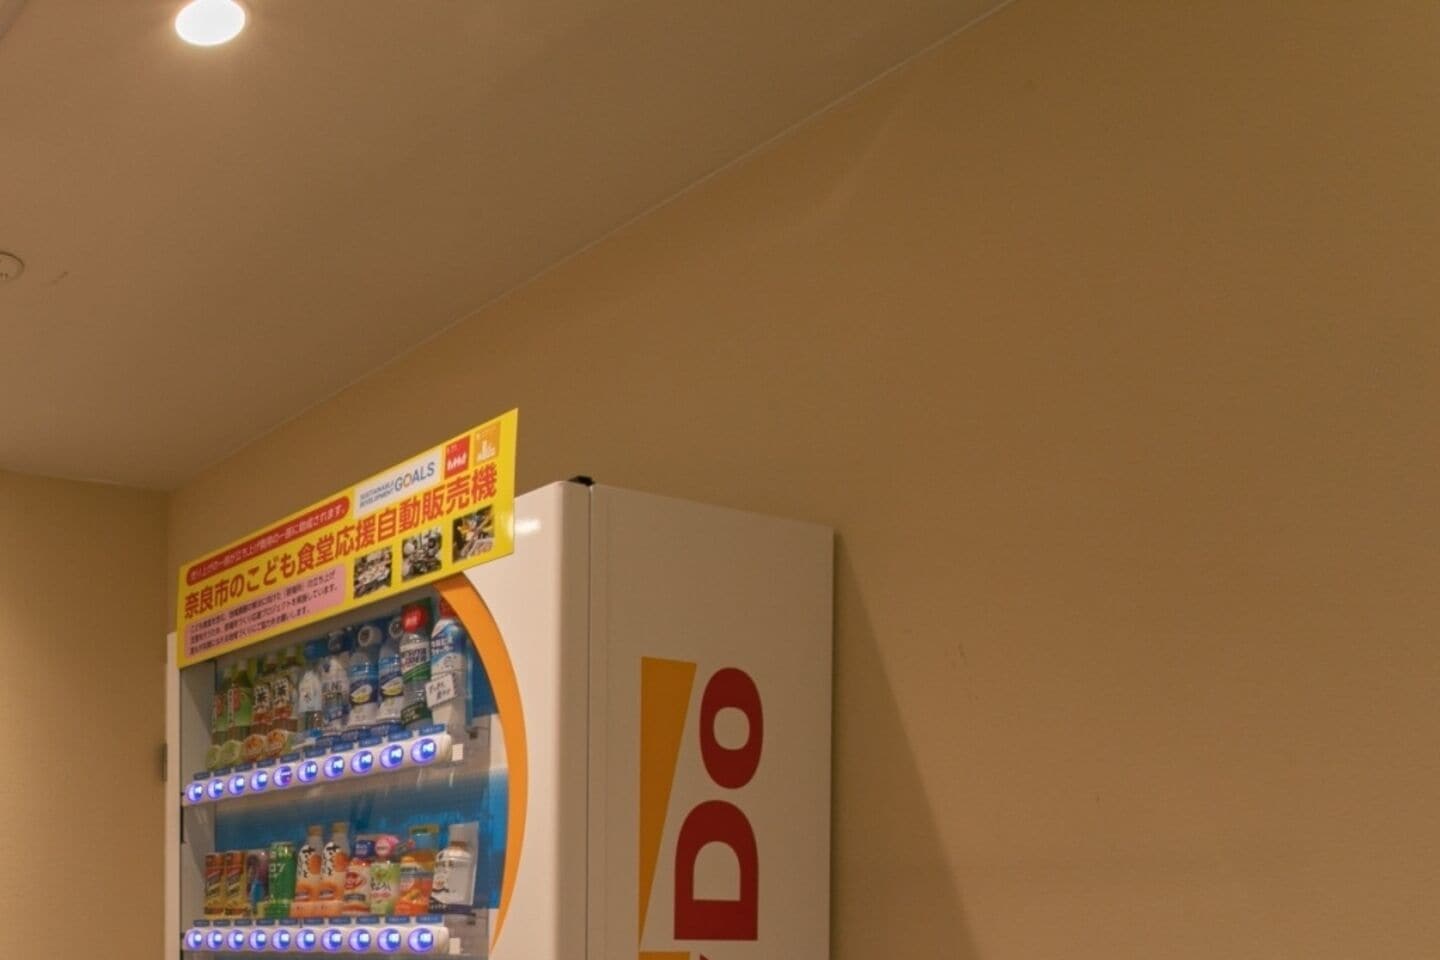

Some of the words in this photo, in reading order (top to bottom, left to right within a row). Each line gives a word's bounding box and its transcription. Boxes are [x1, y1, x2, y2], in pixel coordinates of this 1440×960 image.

[394, 461, 436, 493] GOALS
[184, 463, 498, 618] 奈良市のこども食堂応援自動販売機
